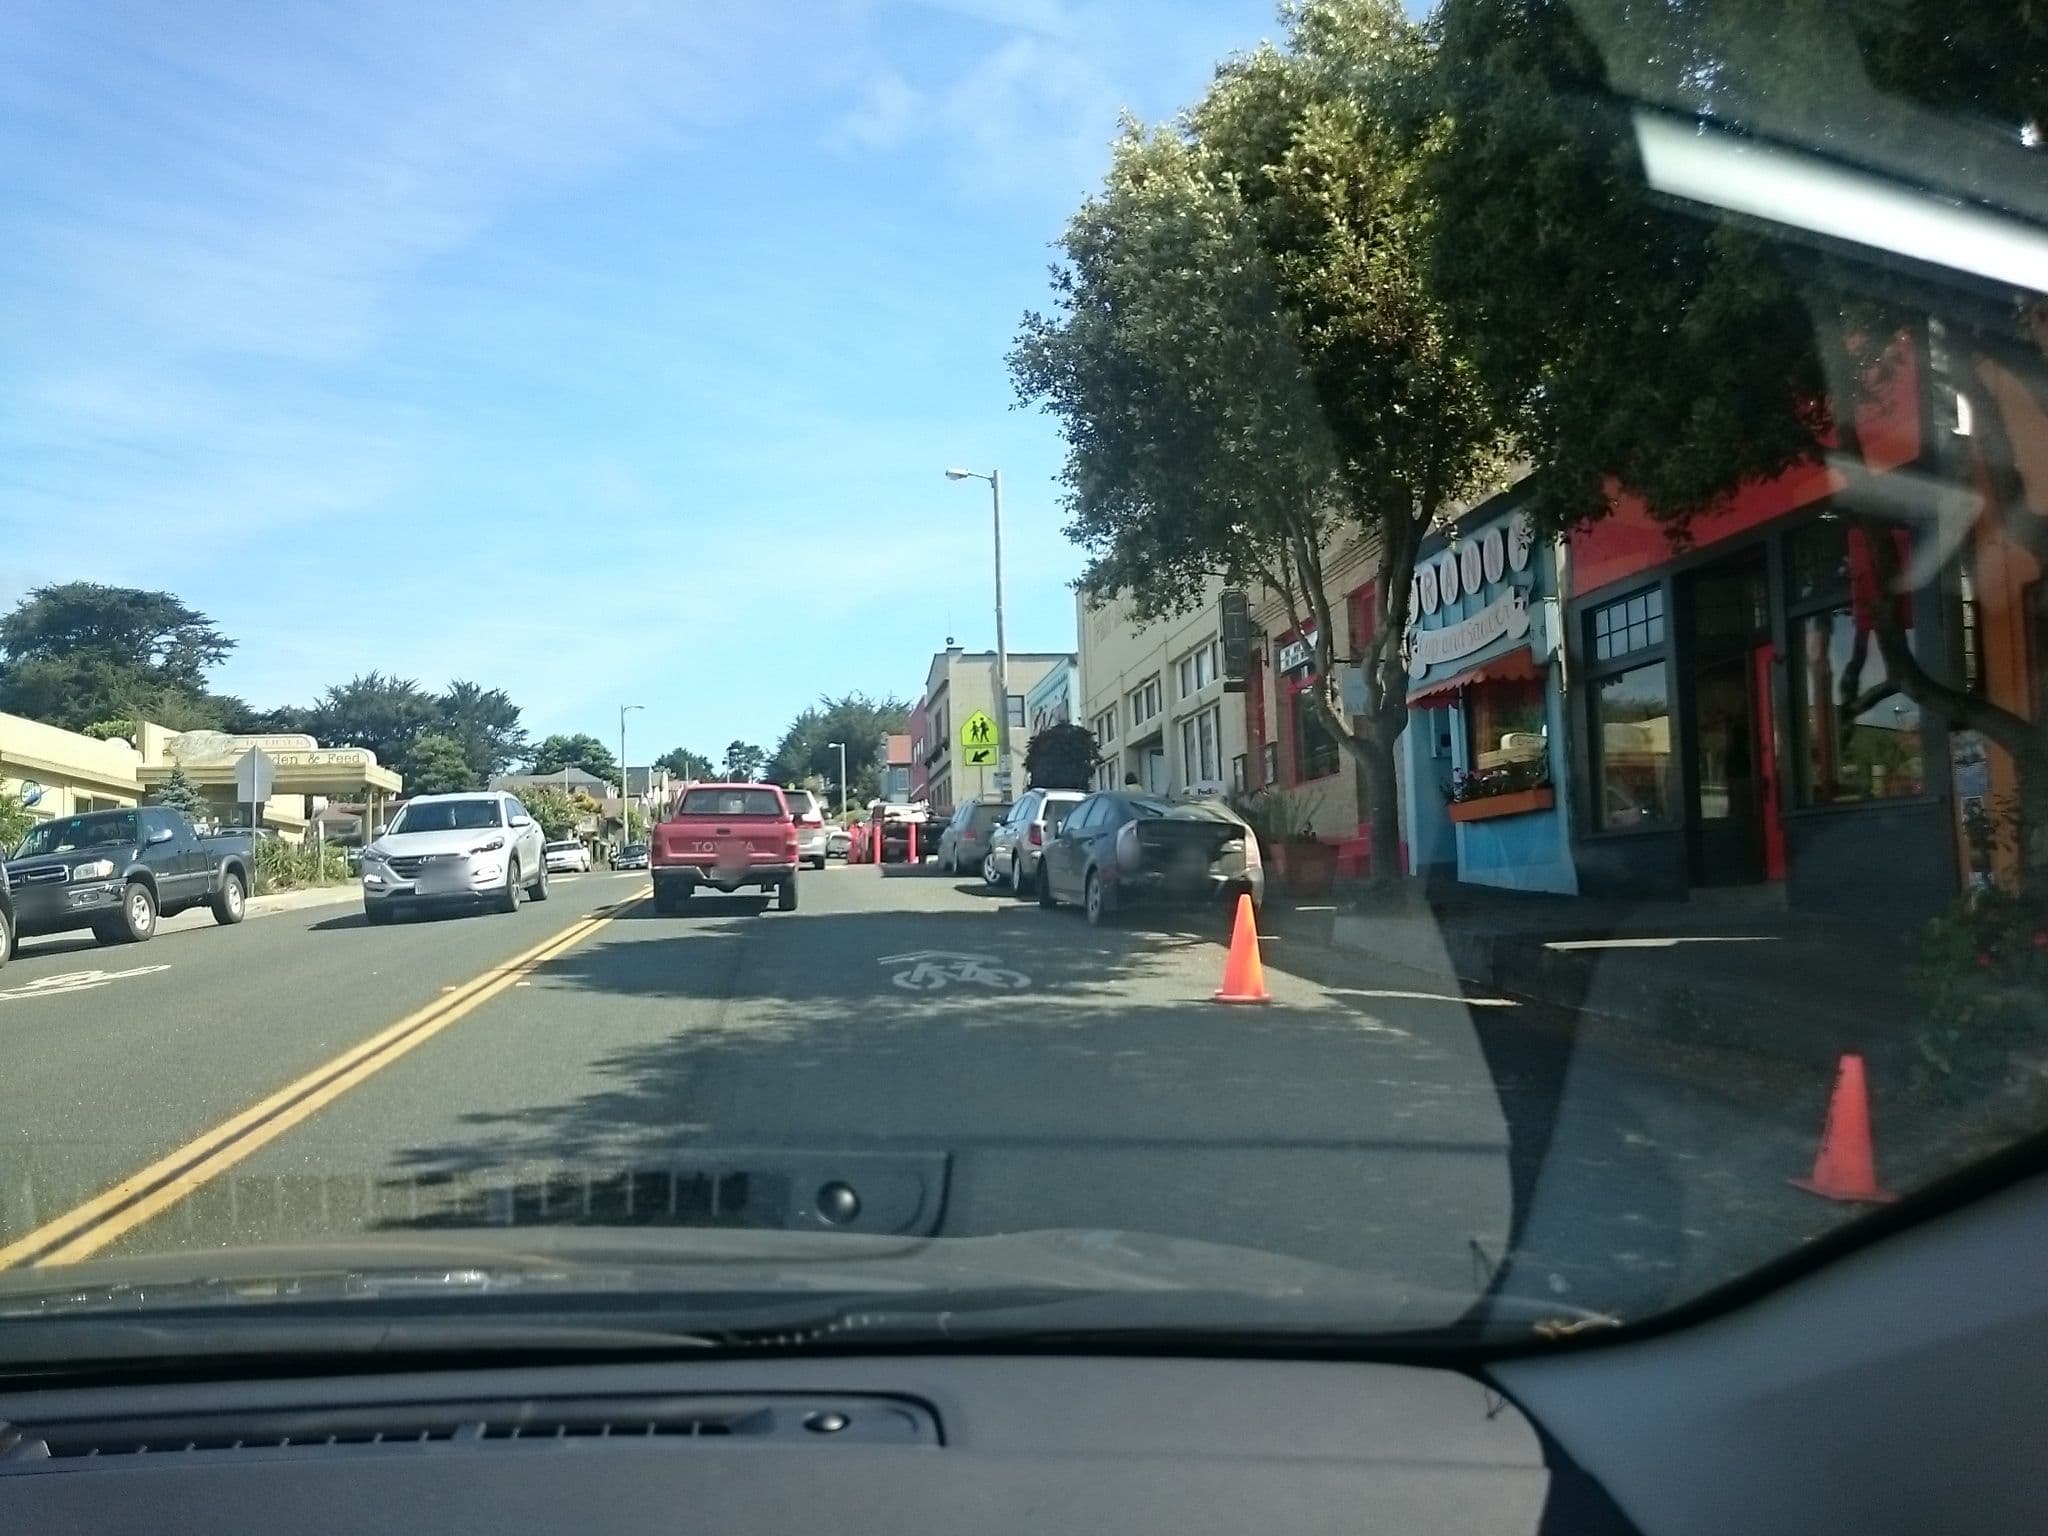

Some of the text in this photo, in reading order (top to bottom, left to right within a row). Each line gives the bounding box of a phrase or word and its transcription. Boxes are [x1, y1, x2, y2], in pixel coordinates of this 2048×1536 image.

[308, 753, 320, 764] &
[328, 753, 360, 764] Feed
[691, 841, 755, 852] TOA
